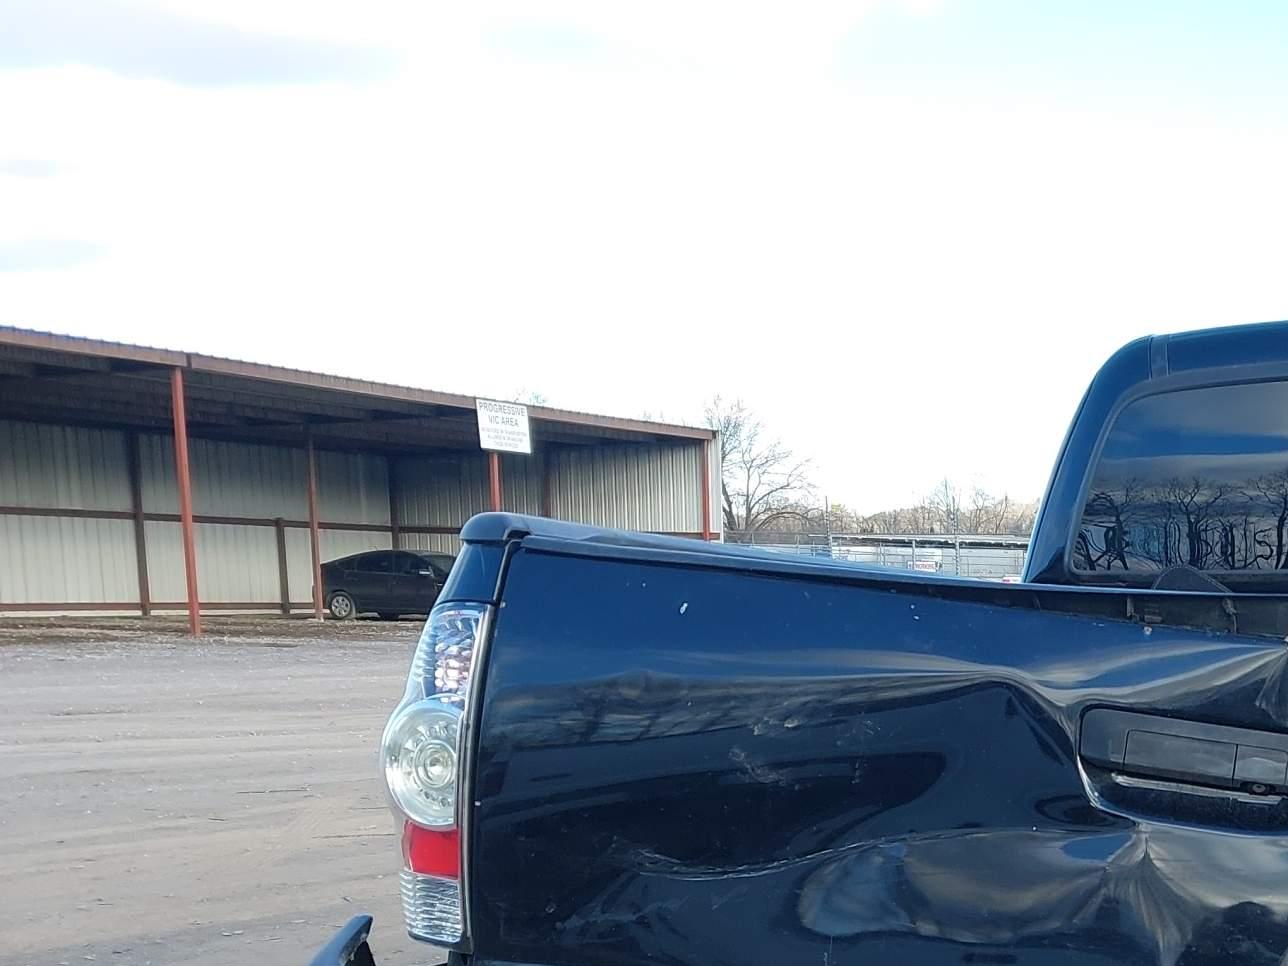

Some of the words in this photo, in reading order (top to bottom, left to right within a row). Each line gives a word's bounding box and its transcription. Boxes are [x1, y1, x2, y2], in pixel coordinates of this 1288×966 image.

[479, 402, 525, 416] PROGRESSIVE
[488, 415, 499, 424] VIC
[501, 415, 519, 427] AREA
